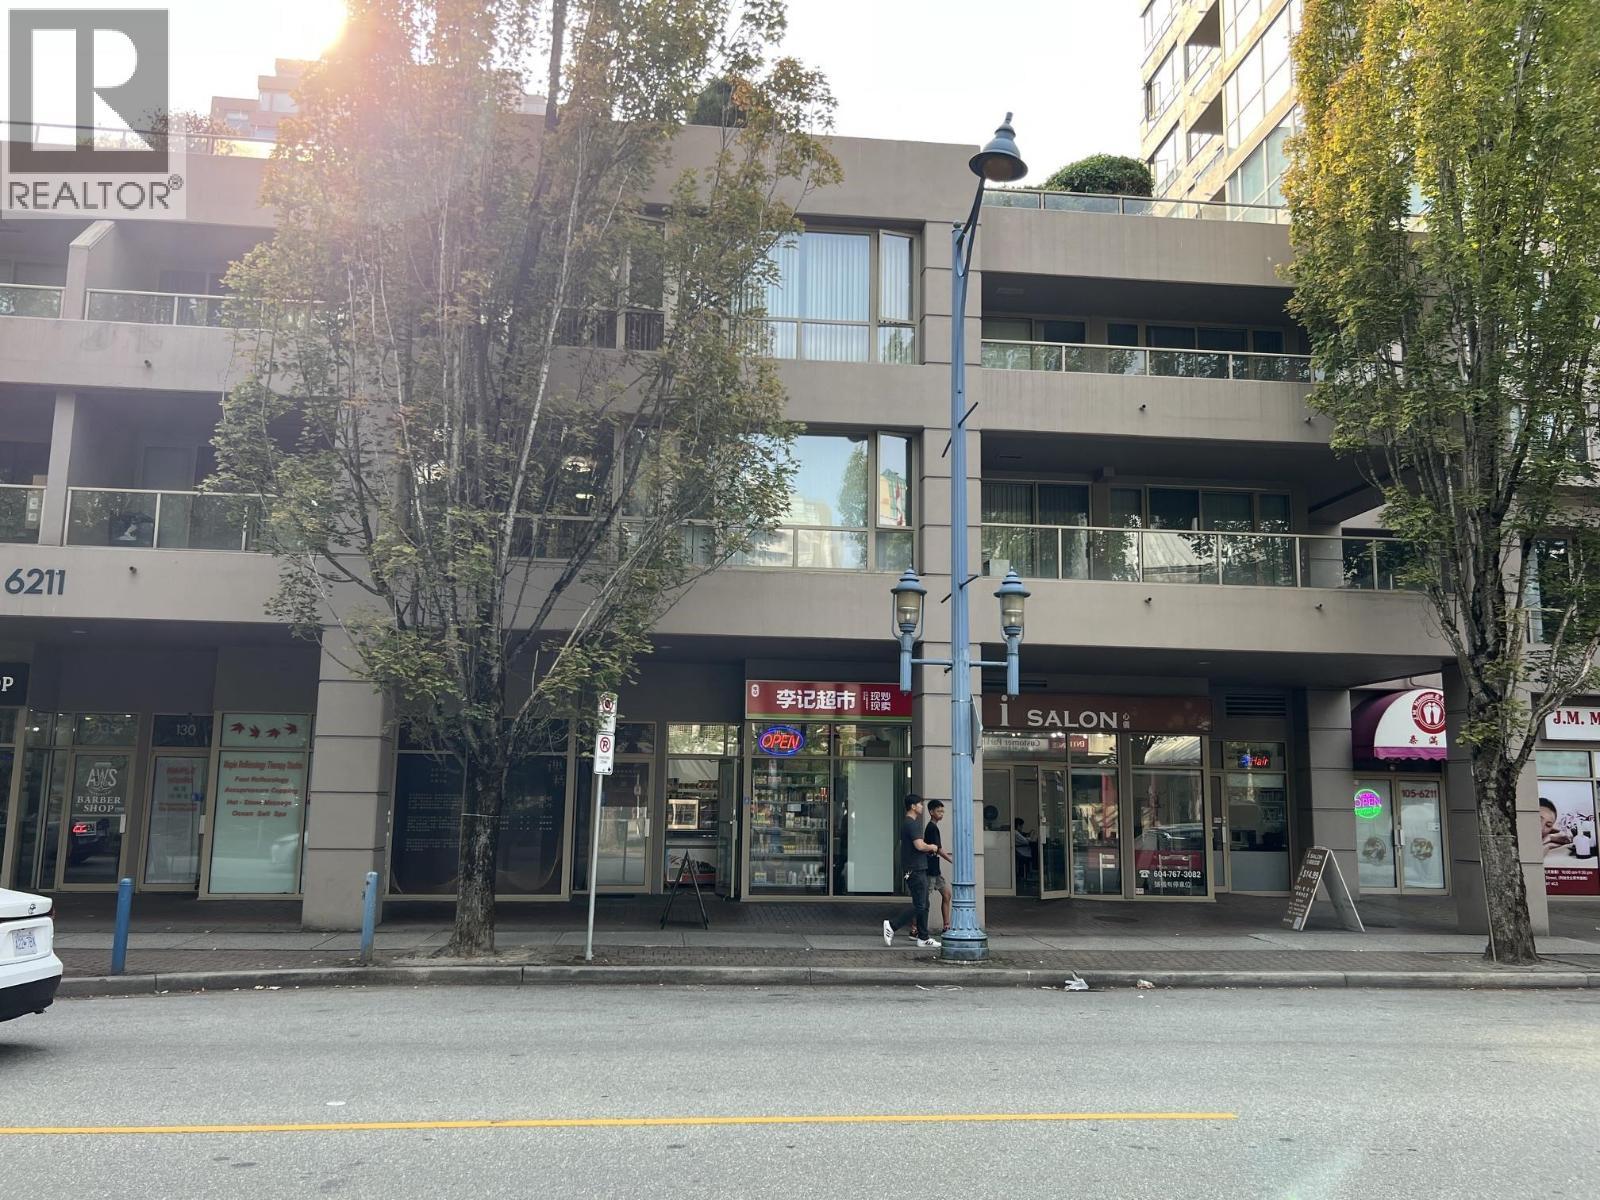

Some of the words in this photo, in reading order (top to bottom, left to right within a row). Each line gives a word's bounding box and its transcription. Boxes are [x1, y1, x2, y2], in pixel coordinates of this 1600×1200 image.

[5, 568, 66, 595] 6211
[0, 676, 14, 691] P
[776, 689, 856, 711] 李记超市
[1000, 694, 1009, 727] i
[1027, 709, 1118, 729] SALON
[1553, 710, 1585, 725] J.M.
[176, 724, 197, 736] 130
[761, 734, 799, 749] OPEN
[86, 768, 118, 787] AWS
[77, 796, 121, 804] BARBER
[1402, 789, 1437, 799] 105-6211
[83, 804, 114, 813] SHOP
[1355, 797, 1383, 808] OPEN
[1153, 870, 1201, 878] 604-767-3082
